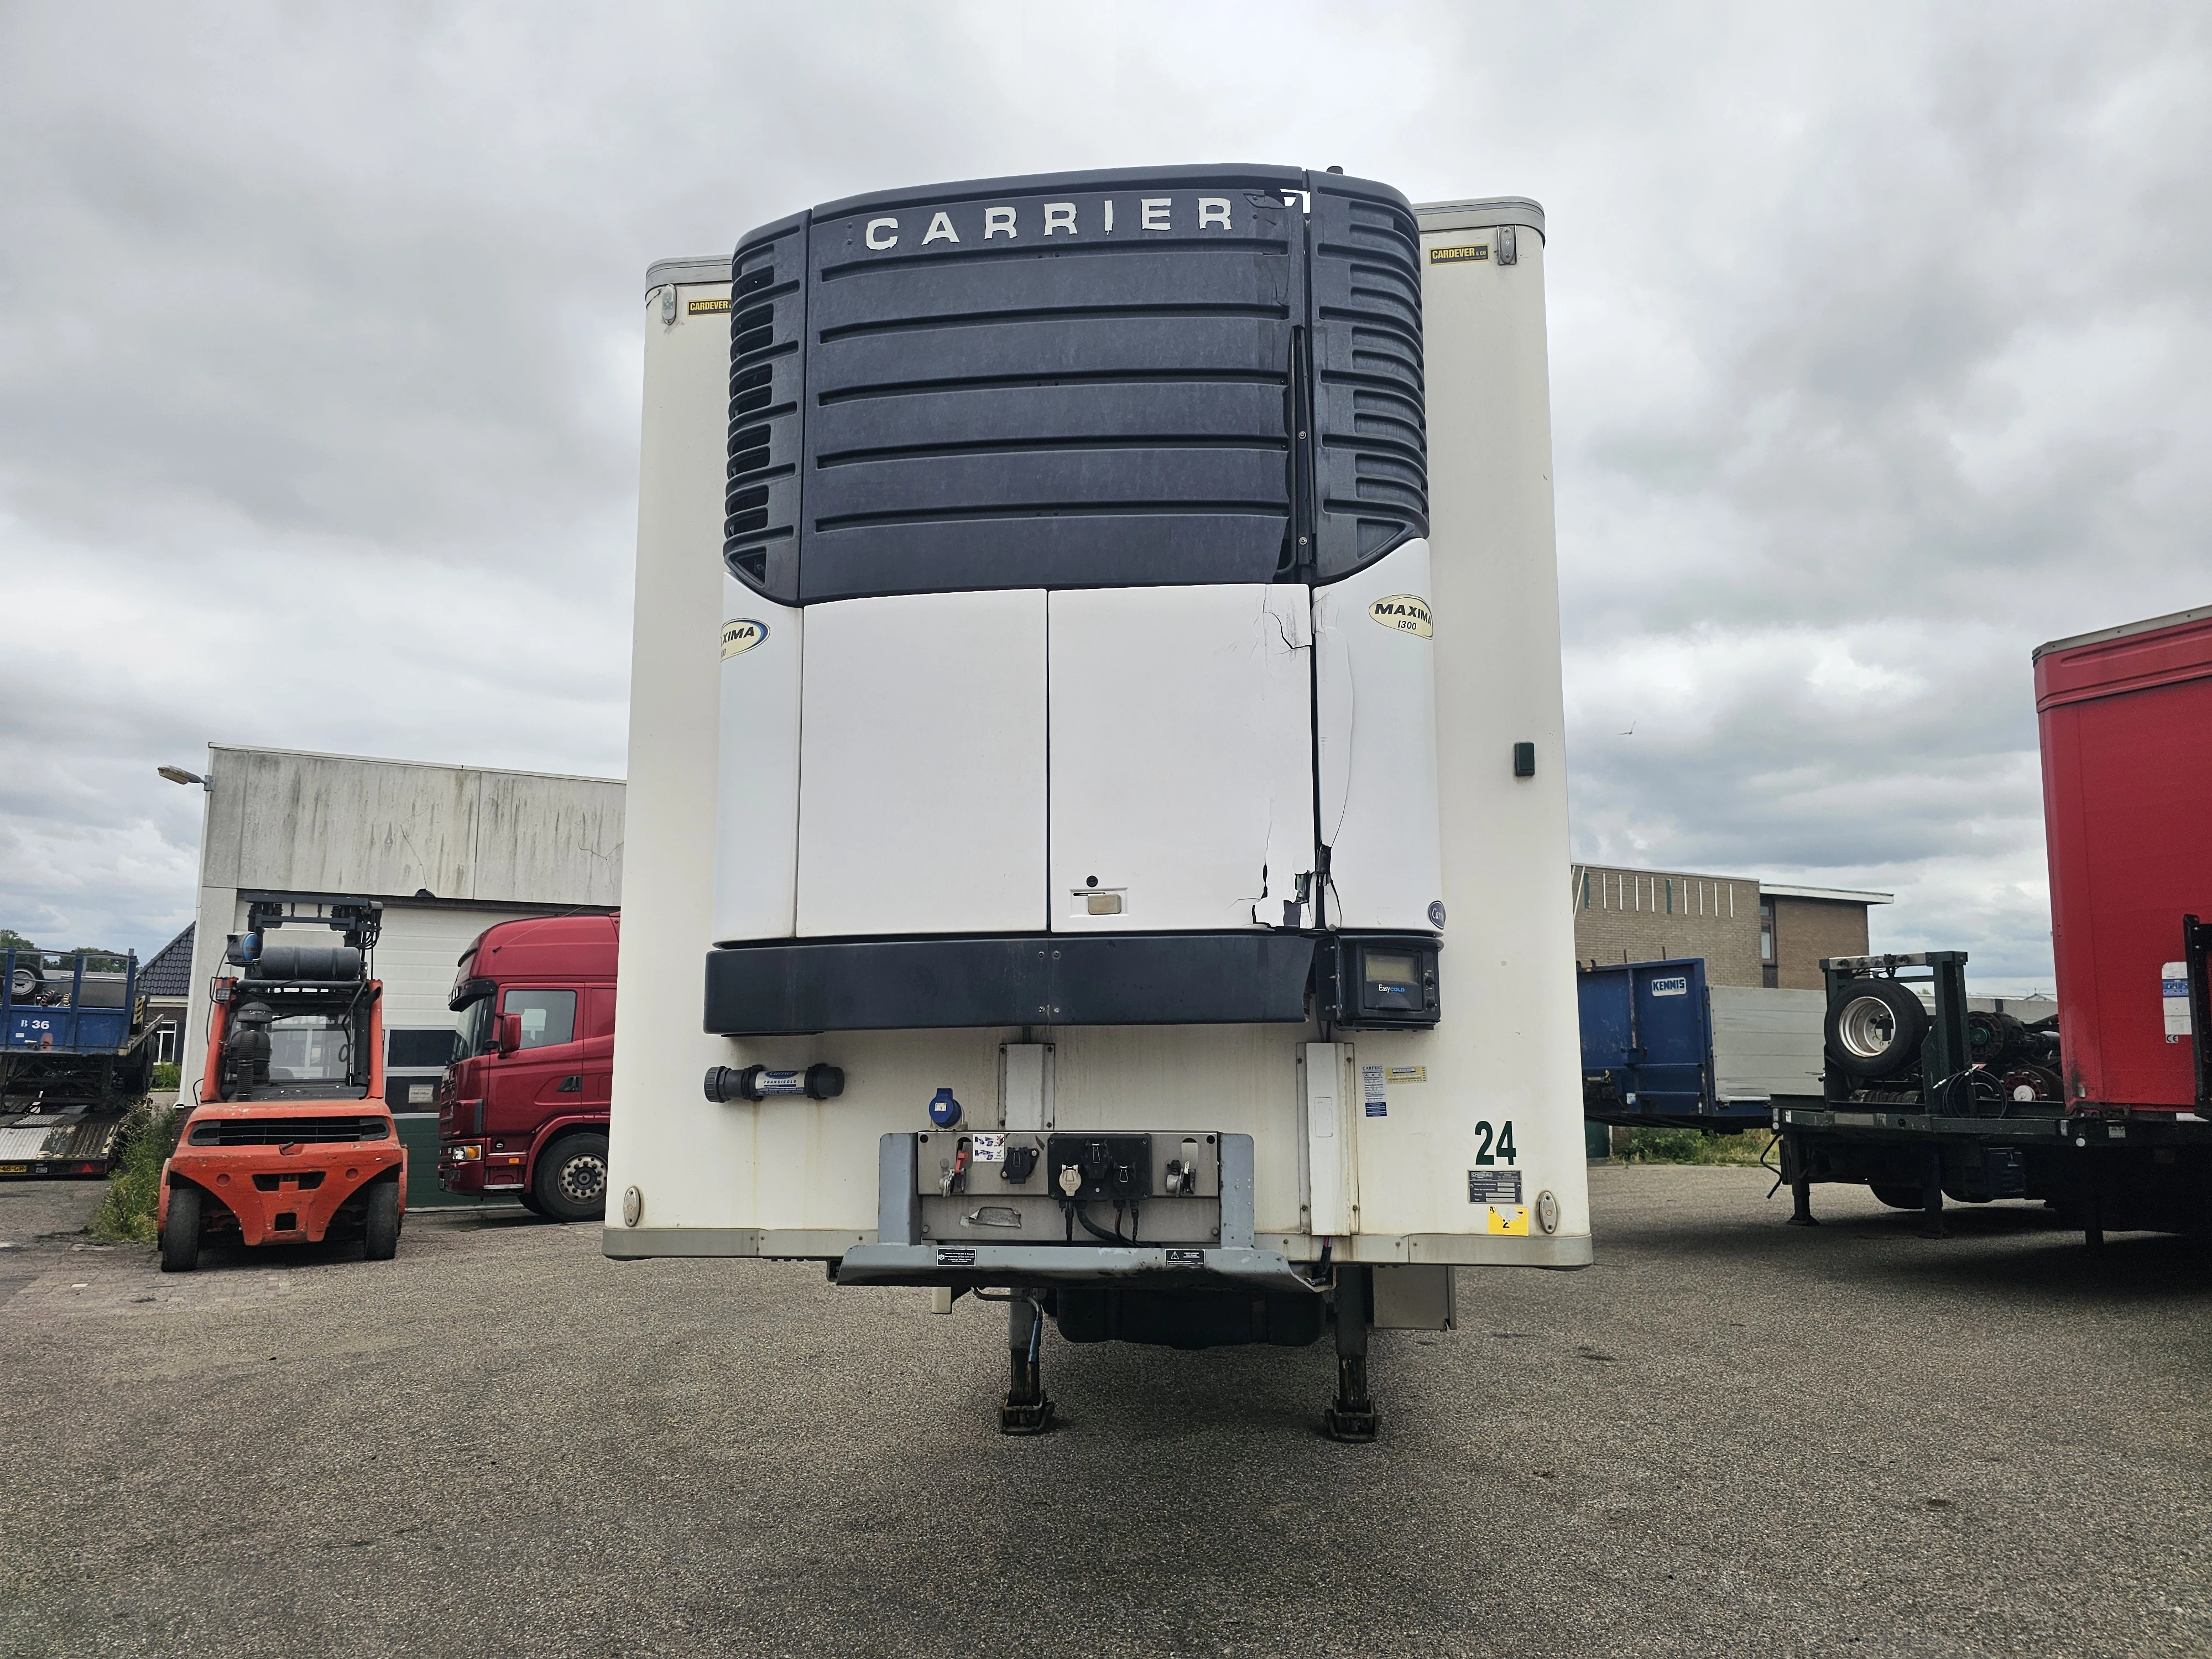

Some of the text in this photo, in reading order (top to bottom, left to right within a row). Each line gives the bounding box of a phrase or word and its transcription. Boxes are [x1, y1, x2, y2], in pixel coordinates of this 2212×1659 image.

[866, 198, 1232, 250] CARRIER
[1432, 247, 1475, 259] CARDEVER
[690, 301, 728, 311] CARDEVER
[1375, 603, 1432, 627] MAXIMA
[1398, 620, 1417, 630] 1300
[1653, 979, 1685, 991] KENNIS
[32, 1020, 50, 1030] 36
[1475, 1121, 1516, 1165] 24
